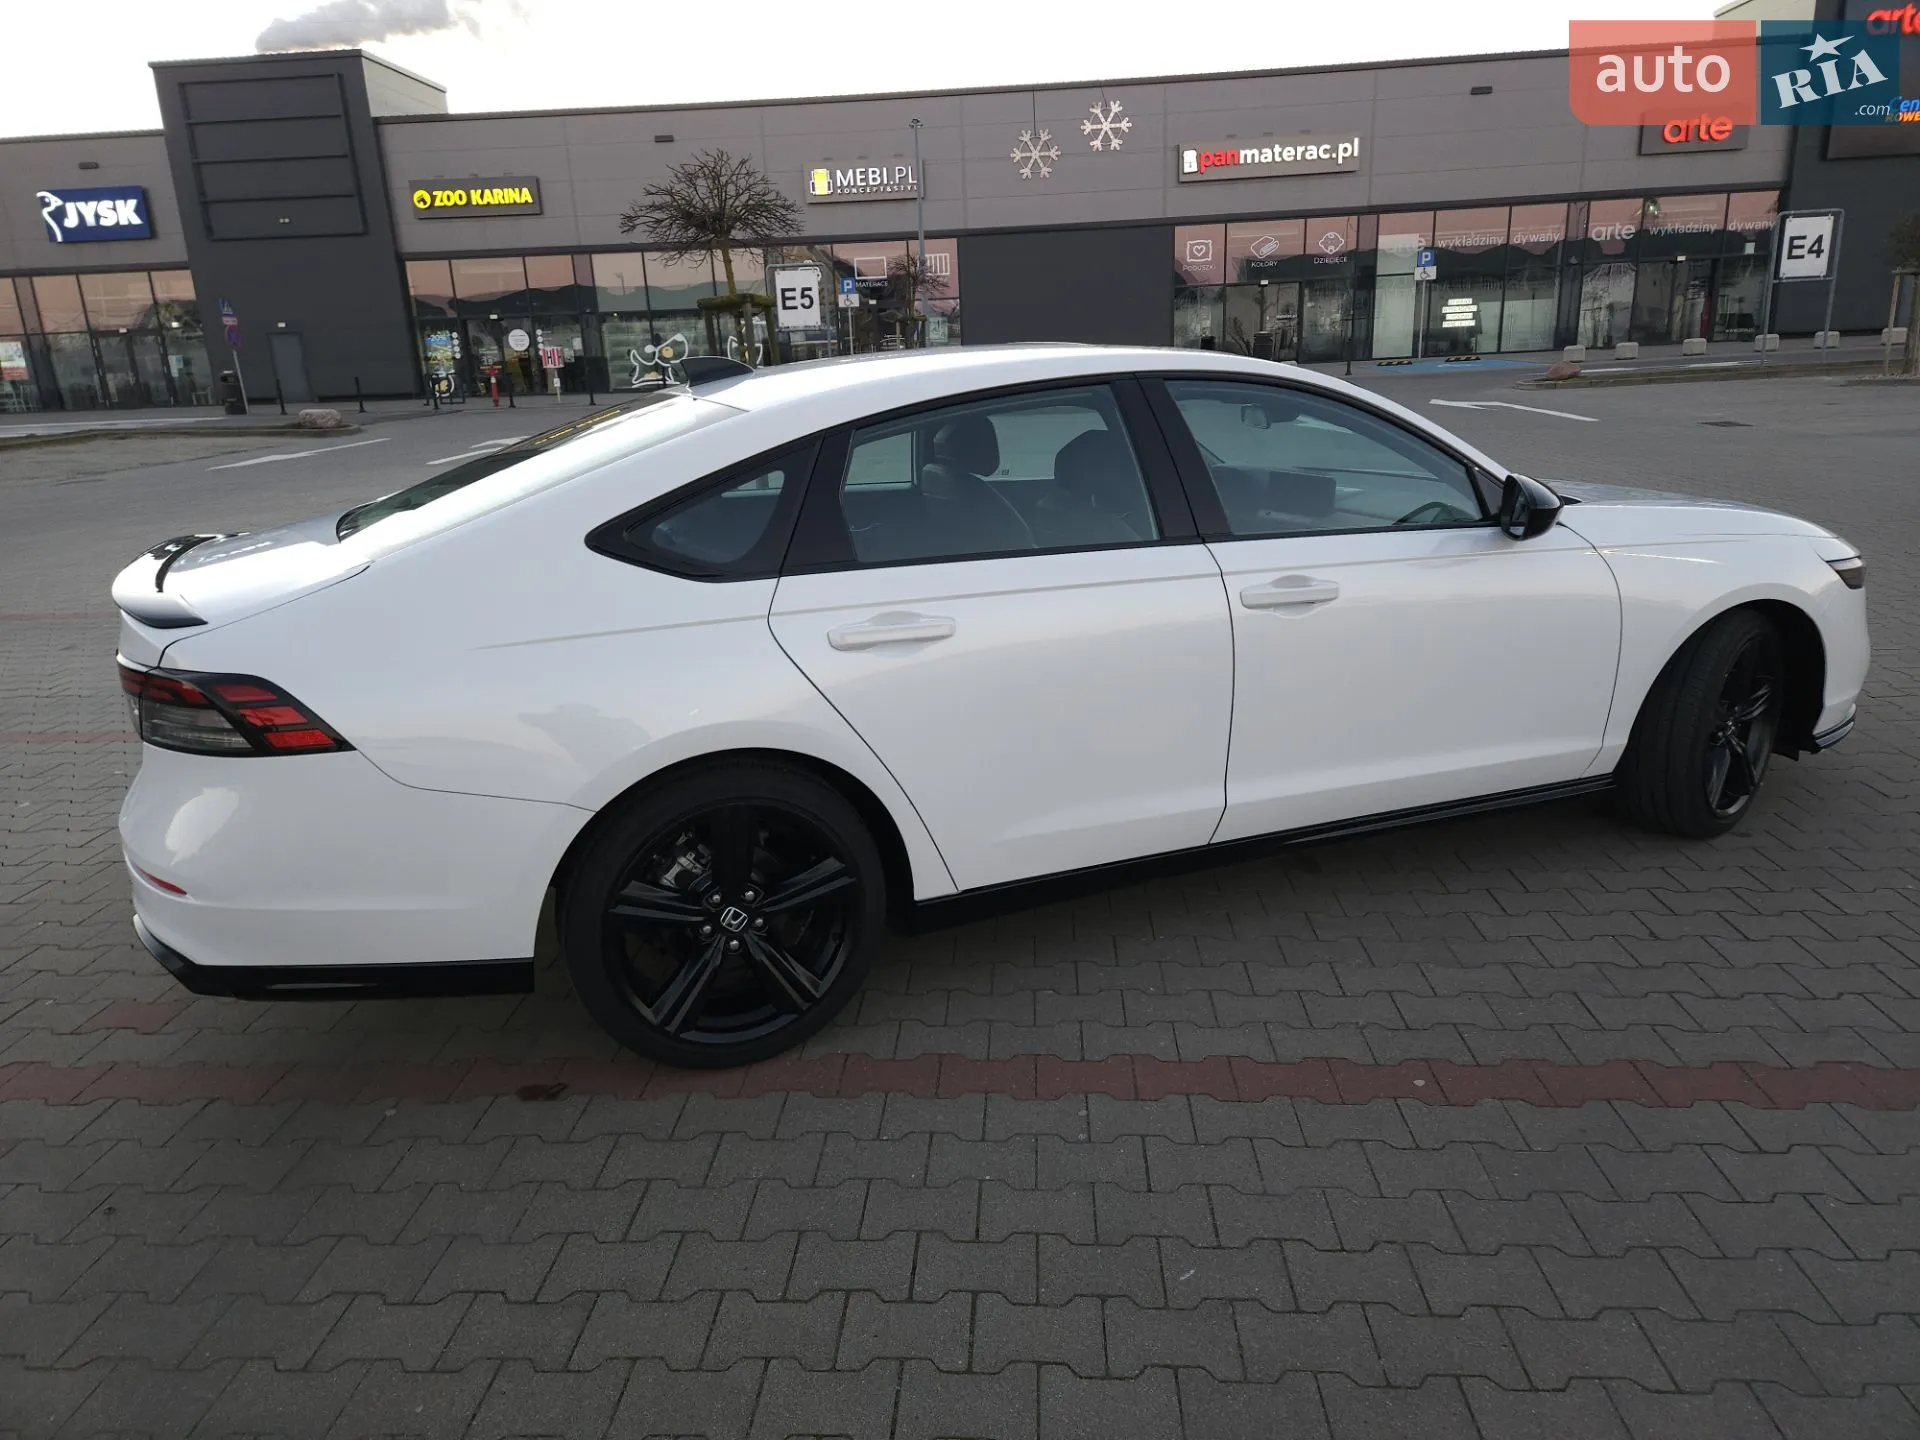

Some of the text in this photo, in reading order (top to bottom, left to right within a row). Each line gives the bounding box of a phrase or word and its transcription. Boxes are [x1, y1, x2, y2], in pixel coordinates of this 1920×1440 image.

[1662, 112, 1733, 143] arte
[1199, 137, 1360, 173] panmaterac.pl
[836, 165, 918, 187] MEBI.PL
[432, 187, 533, 207] ZOO KARINA
[63, 198, 144, 229] JYSK
[1438, 232, 1505, 248] wykładziny
[1513, 229, 1561, 245] dywany
[1591, 218, 1776, 242] arte wykładziny dywany
[1421, 252, 1431, 265] P
[1787, 234, 1824, 260] E4
[843, 279, 853, 293] P
[780, 286, 814, 311] E5
